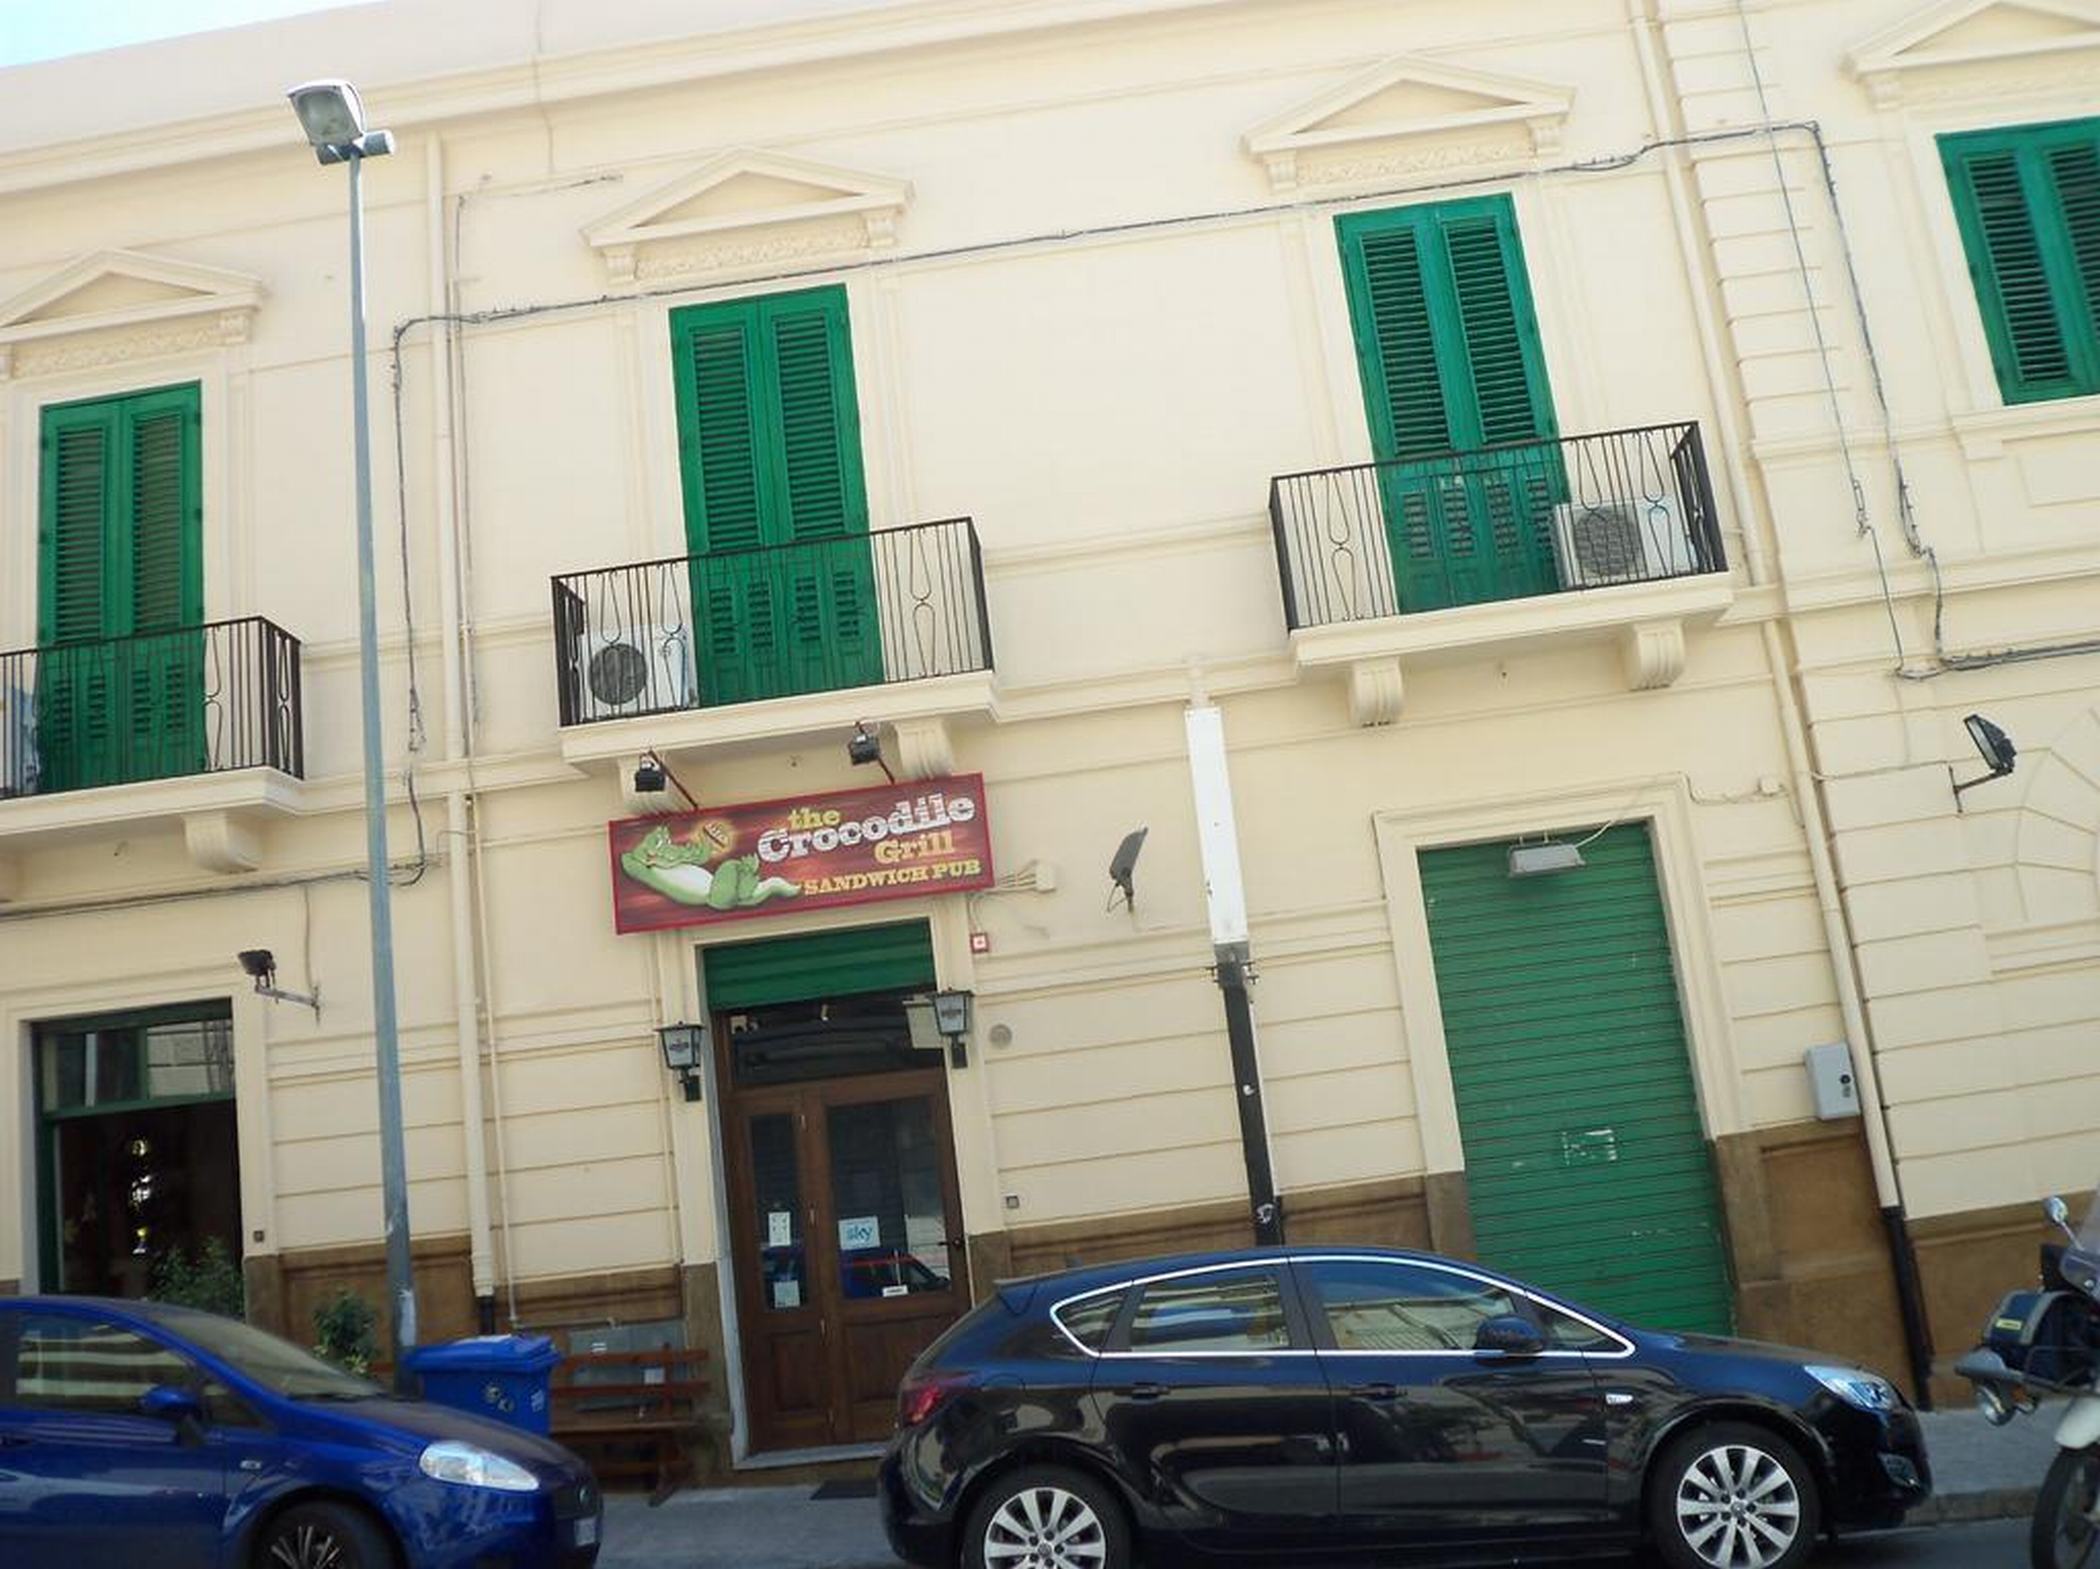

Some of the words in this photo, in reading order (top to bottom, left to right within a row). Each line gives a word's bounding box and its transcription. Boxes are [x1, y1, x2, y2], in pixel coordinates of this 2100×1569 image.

[757, 793, 976, 862] Crocodile
[788, 807, 841, 830] the
[874, 830, 955, 865] Grill
[804, 866, 930, 896] SANDWICH
[932, 859, 982, 880] PUB
